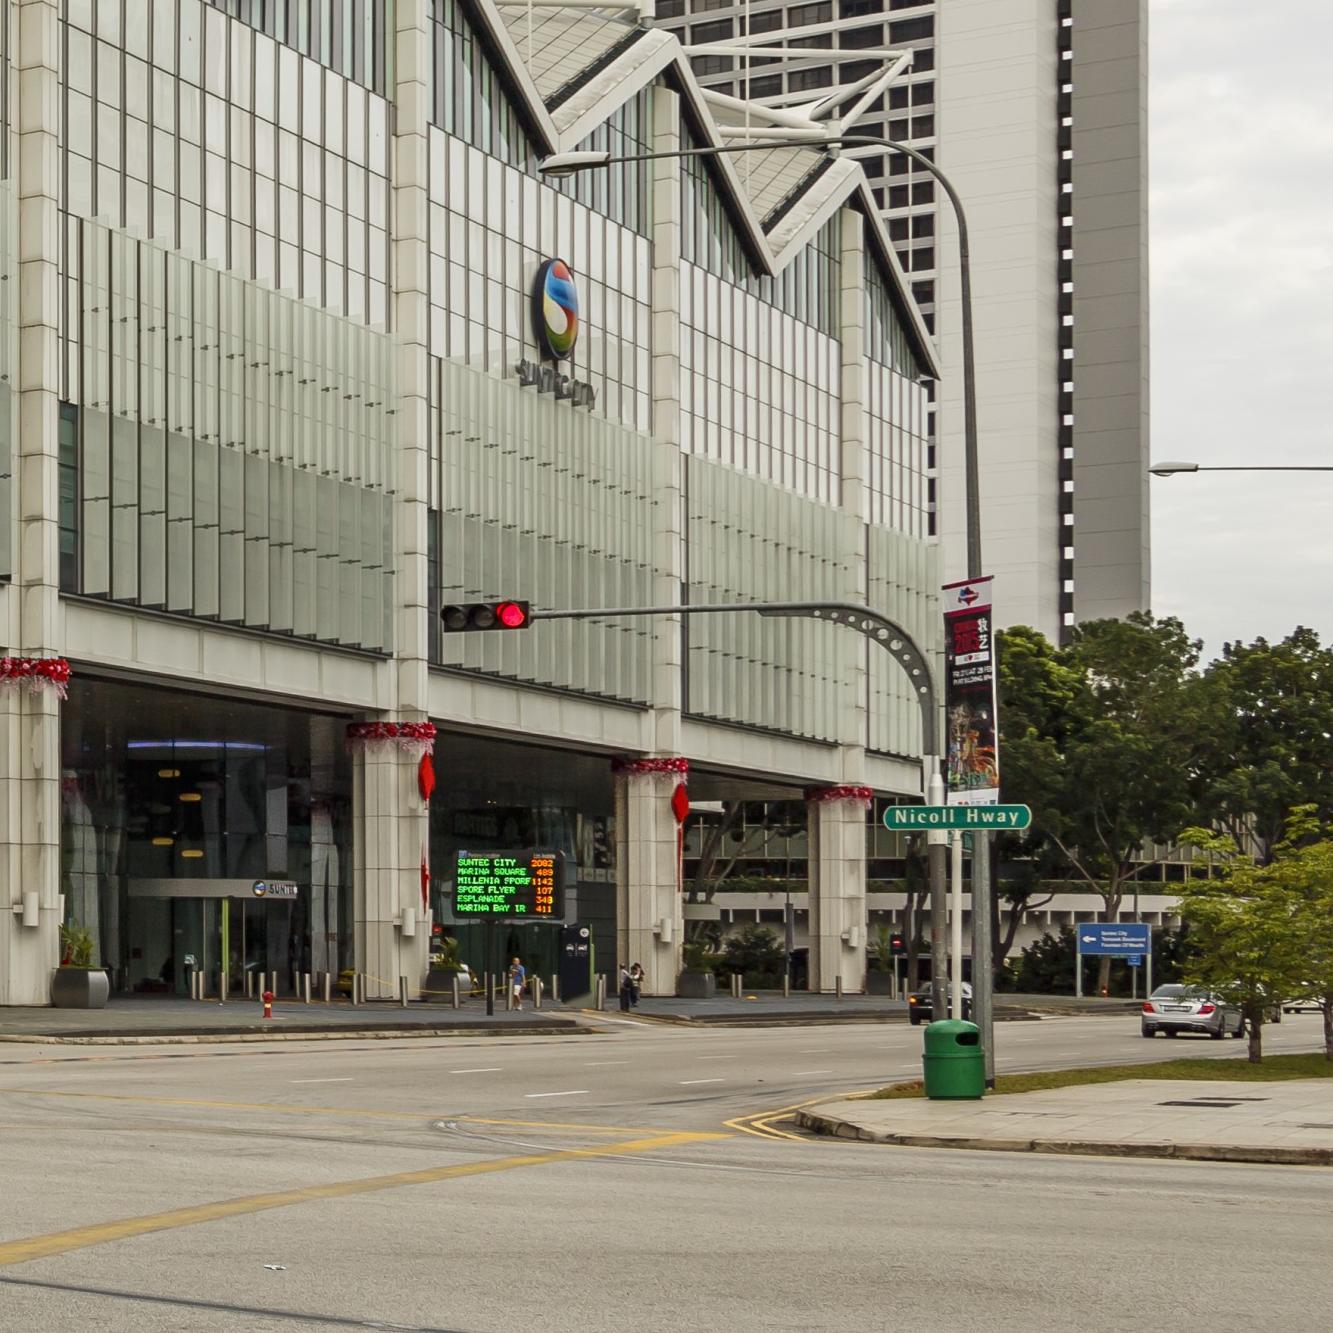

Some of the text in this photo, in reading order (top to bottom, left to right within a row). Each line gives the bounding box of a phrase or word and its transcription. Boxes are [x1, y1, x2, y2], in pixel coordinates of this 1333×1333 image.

[895, 808, 1019, 825] Nicoll Hway
[457, 868, 553, 876] MARINA SQUARE 489
[457, 876, 500, 884] MILLENIA
[532, 877, 553, 885] 1142
[269, 883, 298, 894] SUNTE
[488, 886, 516, 894] FLYER
[536, 886, 553, 895] 107
[457, 895, 505, 903] ESPLANADE
[457, 904, 490, 912] MARINA
[493, 904, 510, 912] BAY
[535, 905, 552, 913] 411
